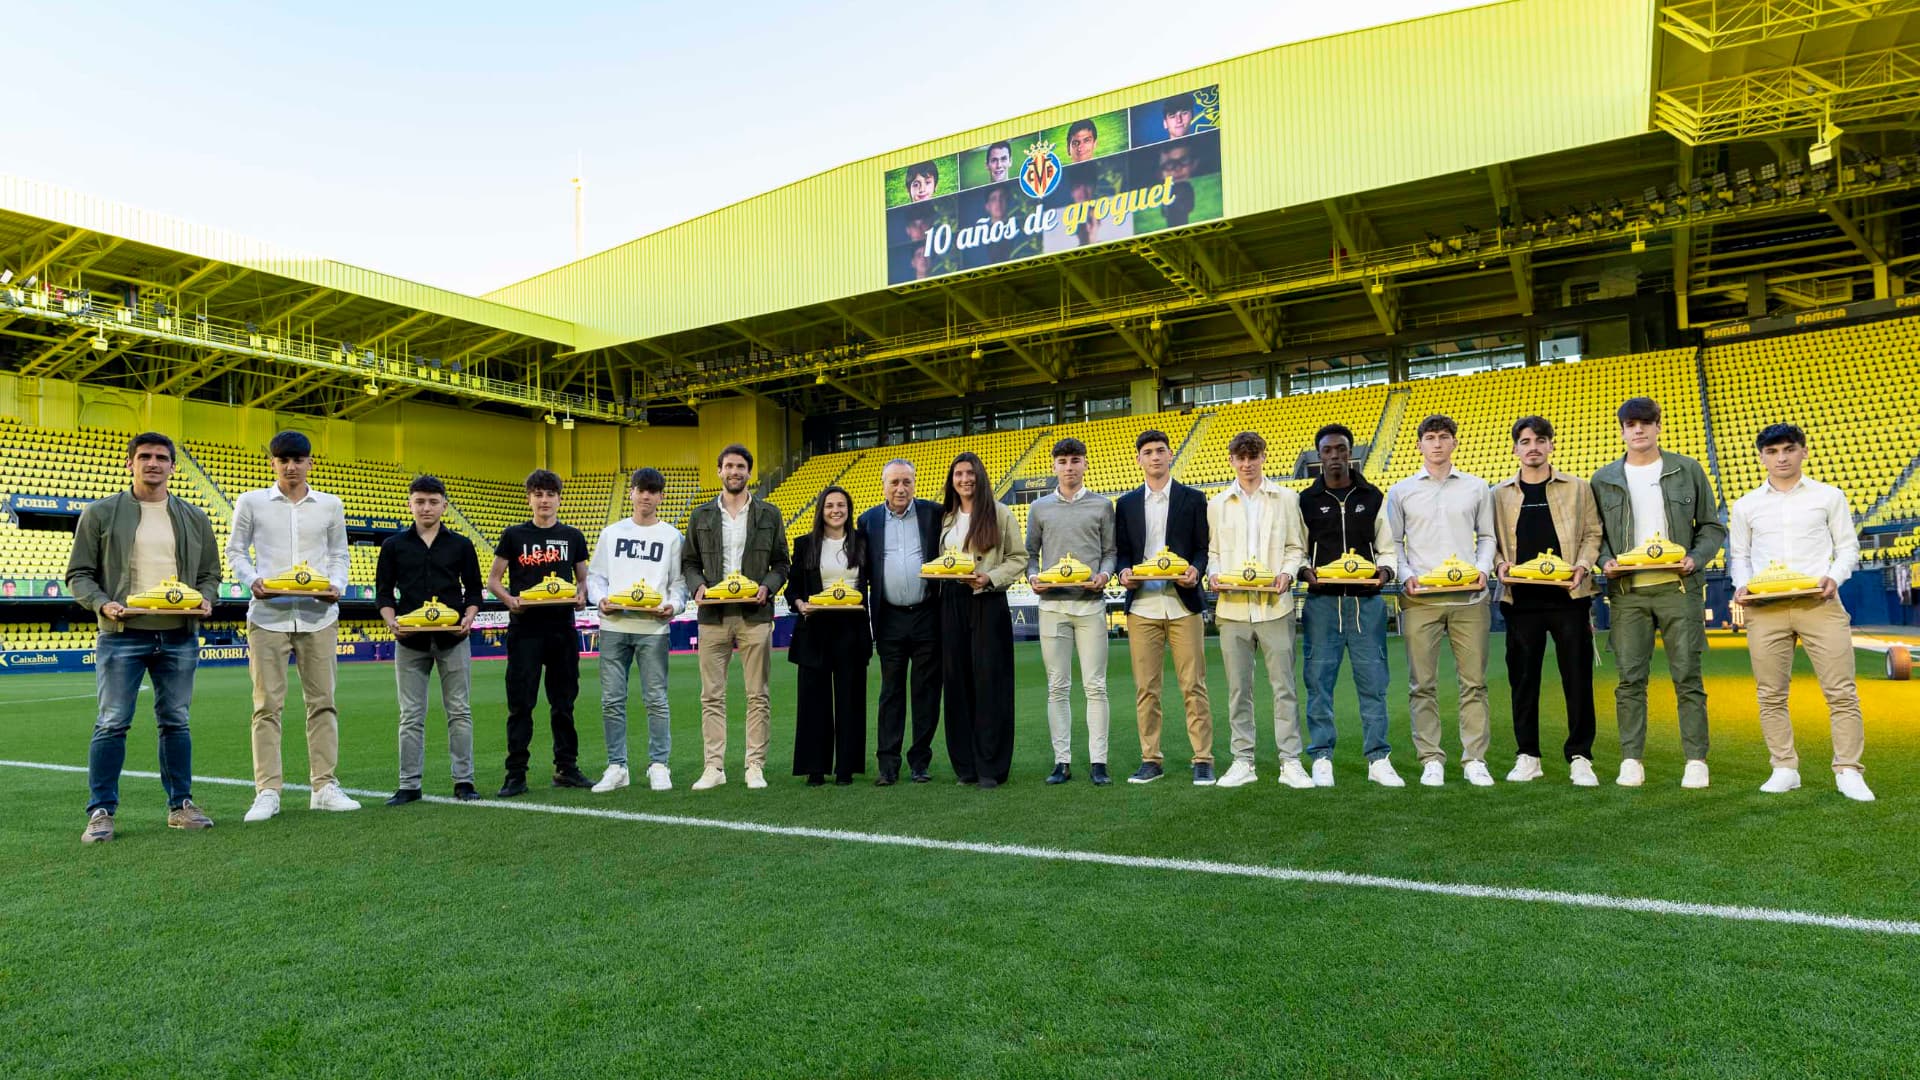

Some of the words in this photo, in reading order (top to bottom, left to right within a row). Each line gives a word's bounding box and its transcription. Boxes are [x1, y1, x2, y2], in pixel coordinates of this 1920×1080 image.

[924, 223, 952, 257] 10
[956, 214, 1019, 251] años
[1023, 203, 1058, 237] de
[1795, 309, 1846, 324] PAMESA
[1704, 324, 1750, 338] PAMESA
[10, 653, 58, 664] CaixaBank
